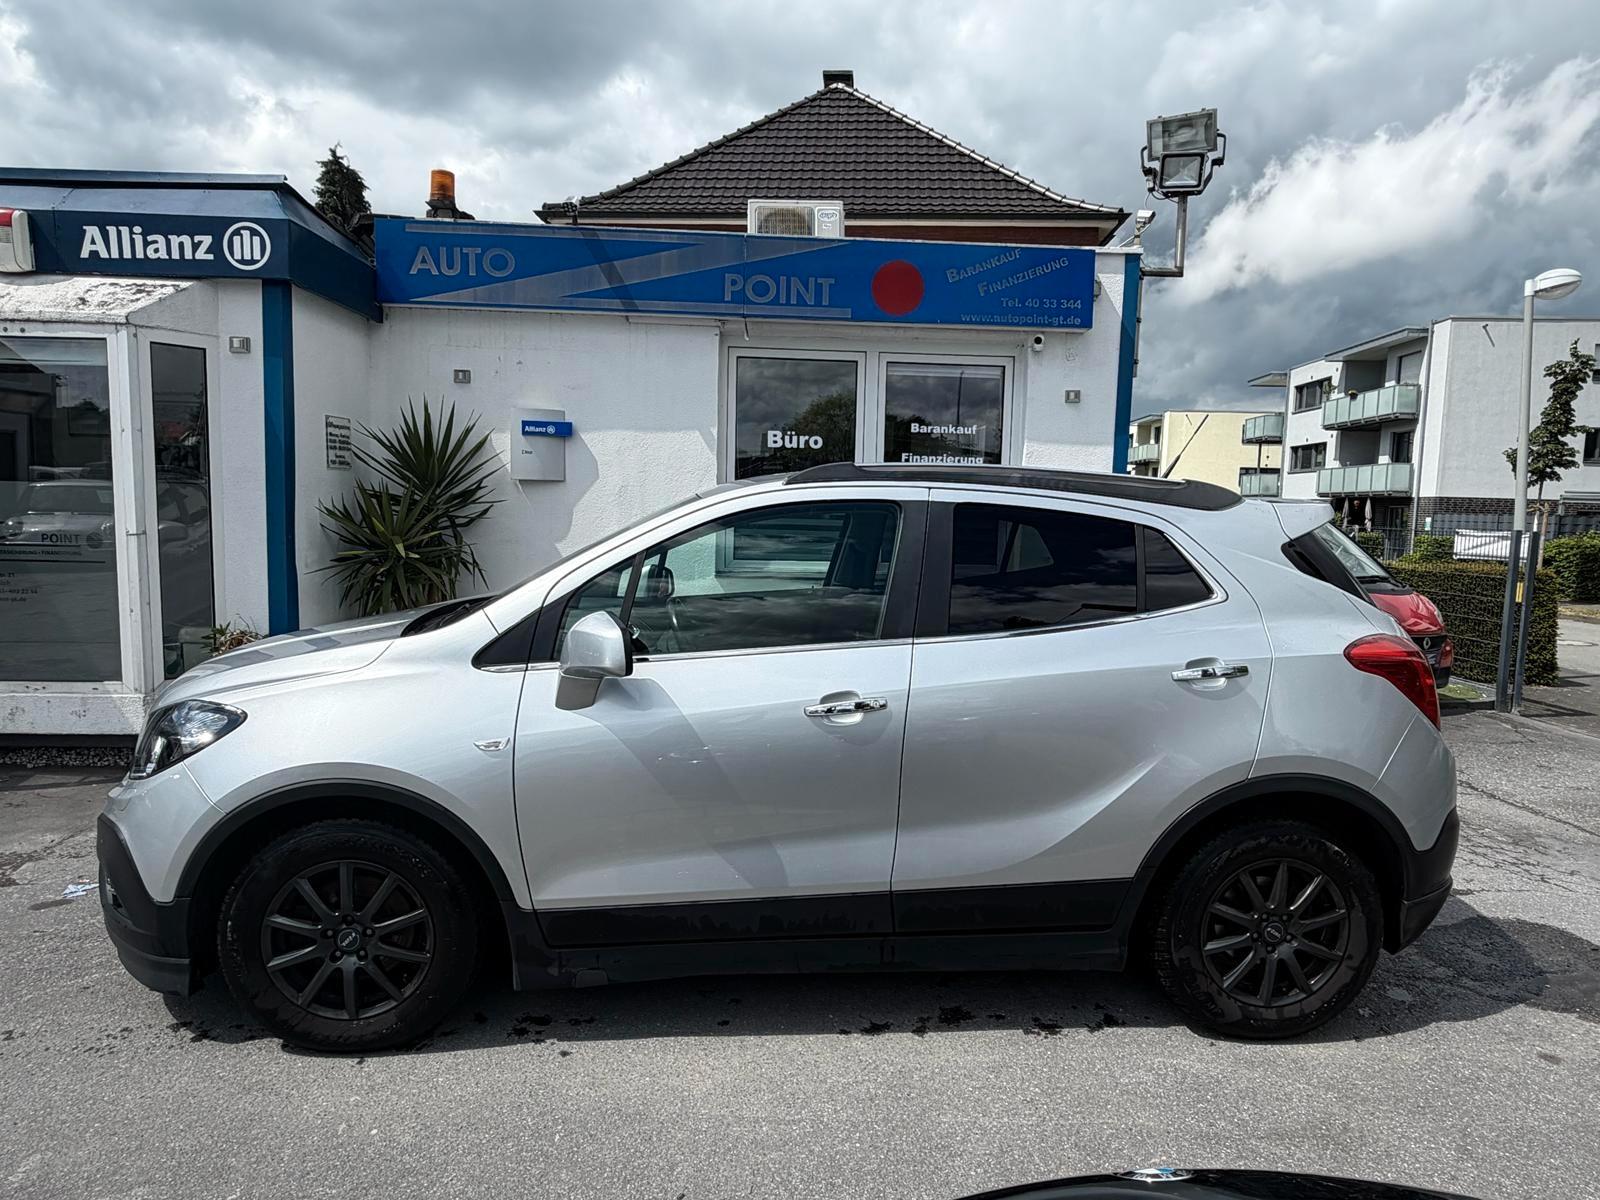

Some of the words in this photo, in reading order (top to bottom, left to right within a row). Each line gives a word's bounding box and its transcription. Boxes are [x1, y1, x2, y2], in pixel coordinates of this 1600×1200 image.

[80, 225, 214, 260] Allianz
[409, 246, 516, 277] AUTO
[946, 248, 1022, 282] BARANKAUF
[977, 257, 1069, 296] FINANZIERUNG
[724, 274, 834, 305] POINT
[1001, 297, 1022, 308] Tel.
[1025, 298, 1040, 308] 40
[1043, 299, 1057, 309] 33
[1060, 299, 1081, 310] 344
[960, 313, 1081, 325] www.autopoint-gt.de
[910, 423, 978, 435] Barankauf
[767, 430, 823, 449] Büro
[901, 452, 984, 464] Finanzierung
[41, 533, 80, 543] POINT
